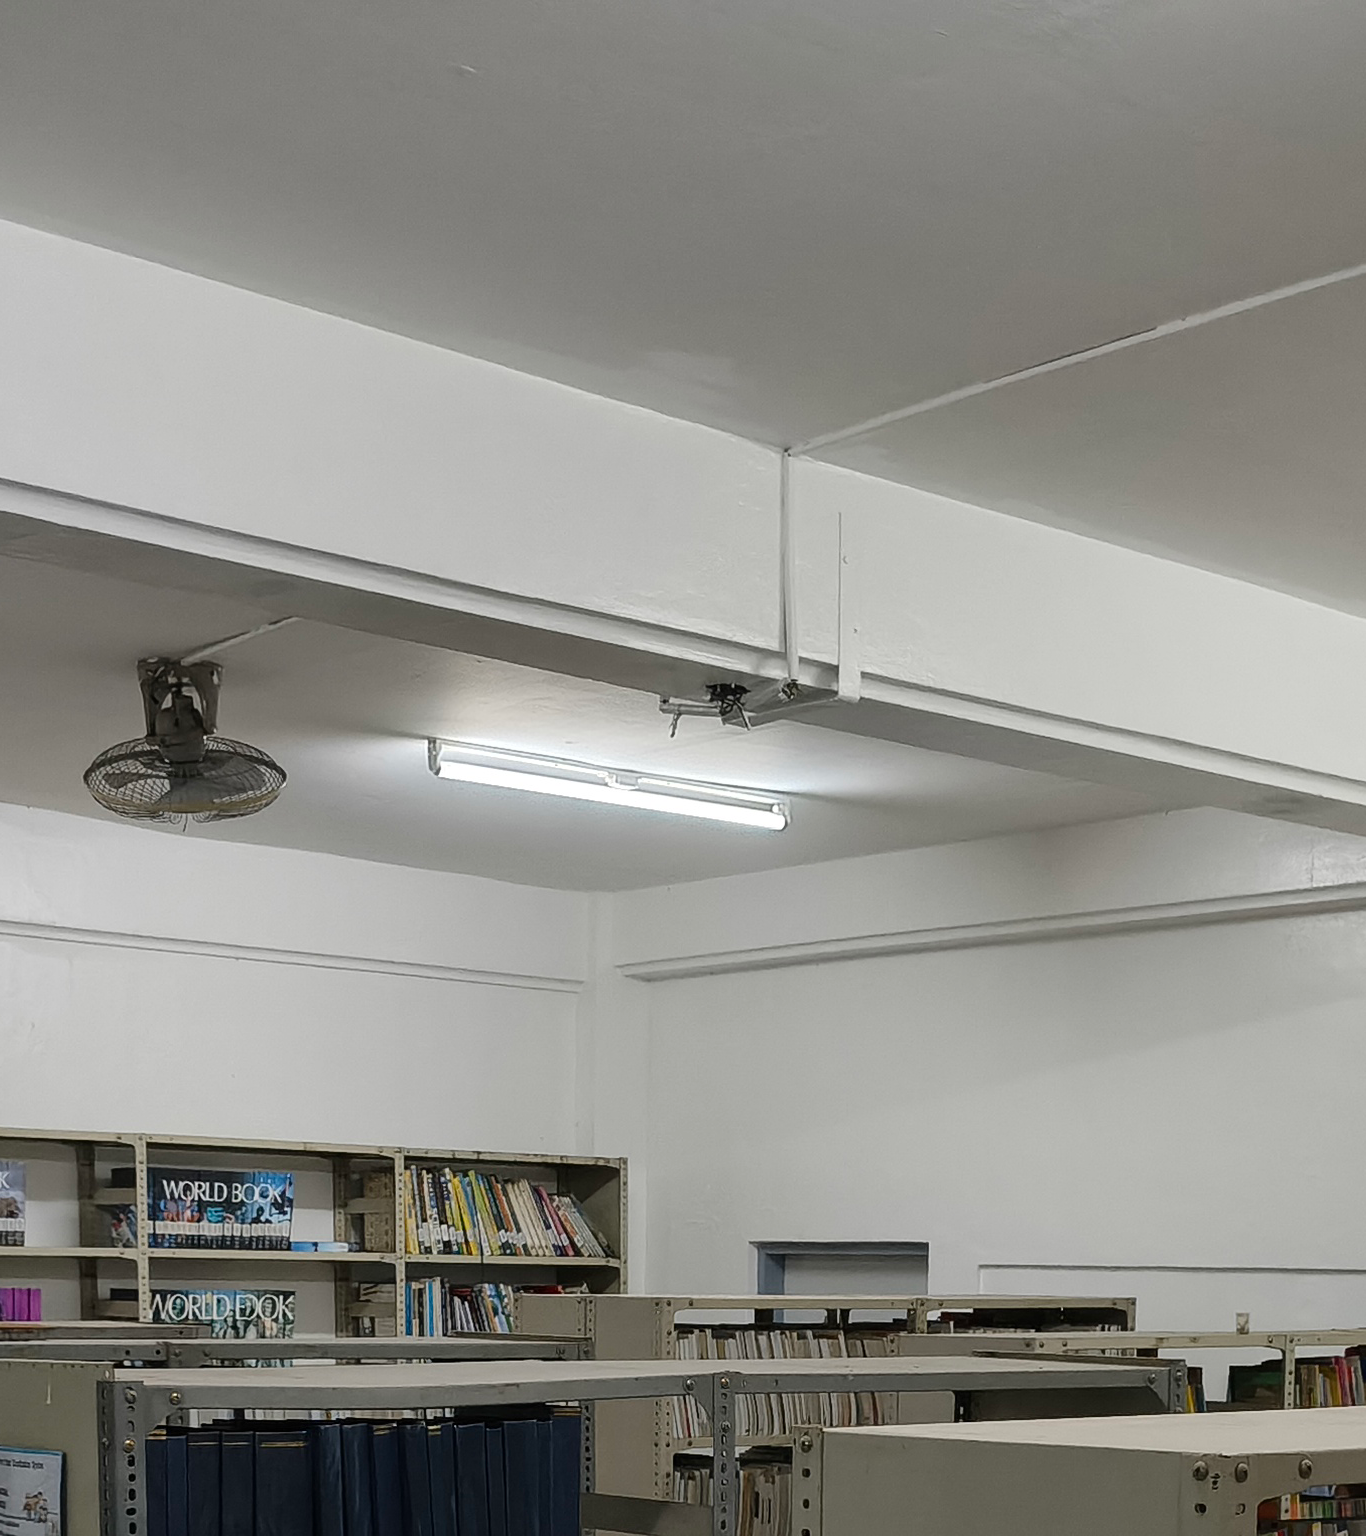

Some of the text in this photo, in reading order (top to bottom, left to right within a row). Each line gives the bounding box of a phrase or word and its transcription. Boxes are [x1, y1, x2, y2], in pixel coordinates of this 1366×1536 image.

[162, 1179, 284, 1205] WORLD BOOK
[148, 1293, 229, 1322] WORLD
